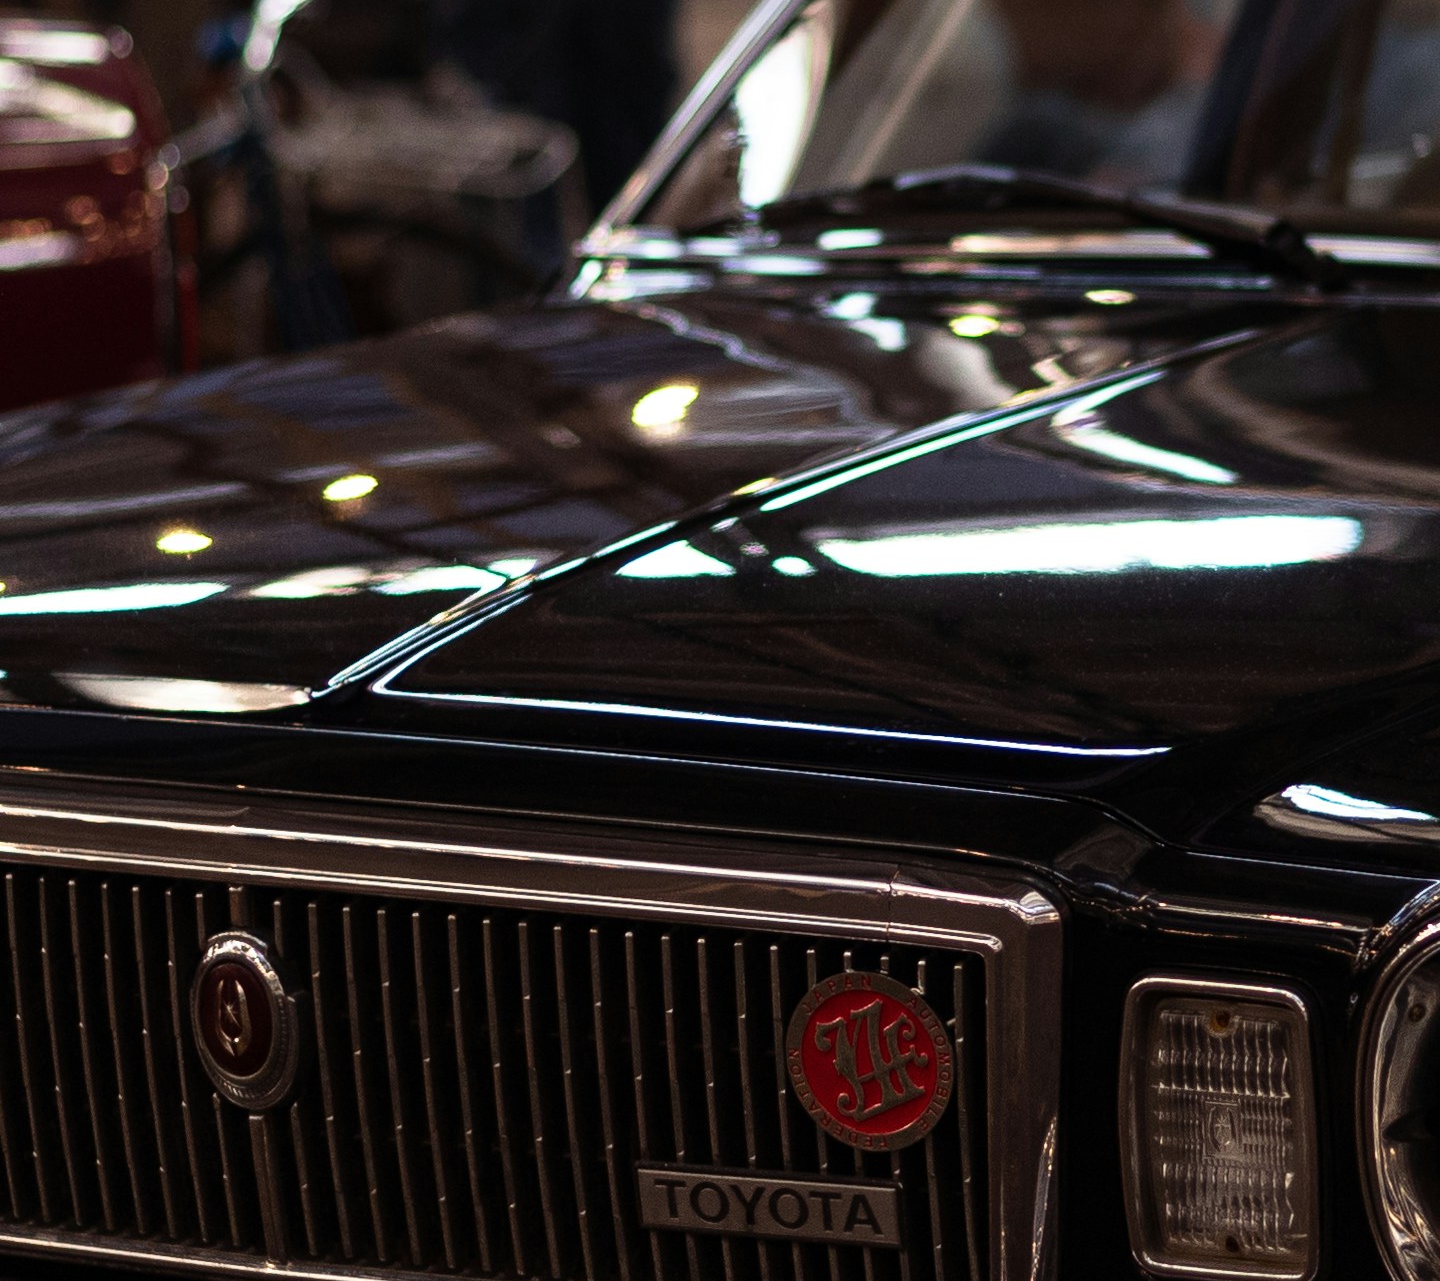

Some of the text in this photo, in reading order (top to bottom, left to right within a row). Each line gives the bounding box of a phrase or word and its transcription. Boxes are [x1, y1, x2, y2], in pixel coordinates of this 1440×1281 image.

[787, 975, 952, 1149] JAPAN AUTOMOBILE FEDERATION
[654, 1177, 885, 1236] TOYOTA
